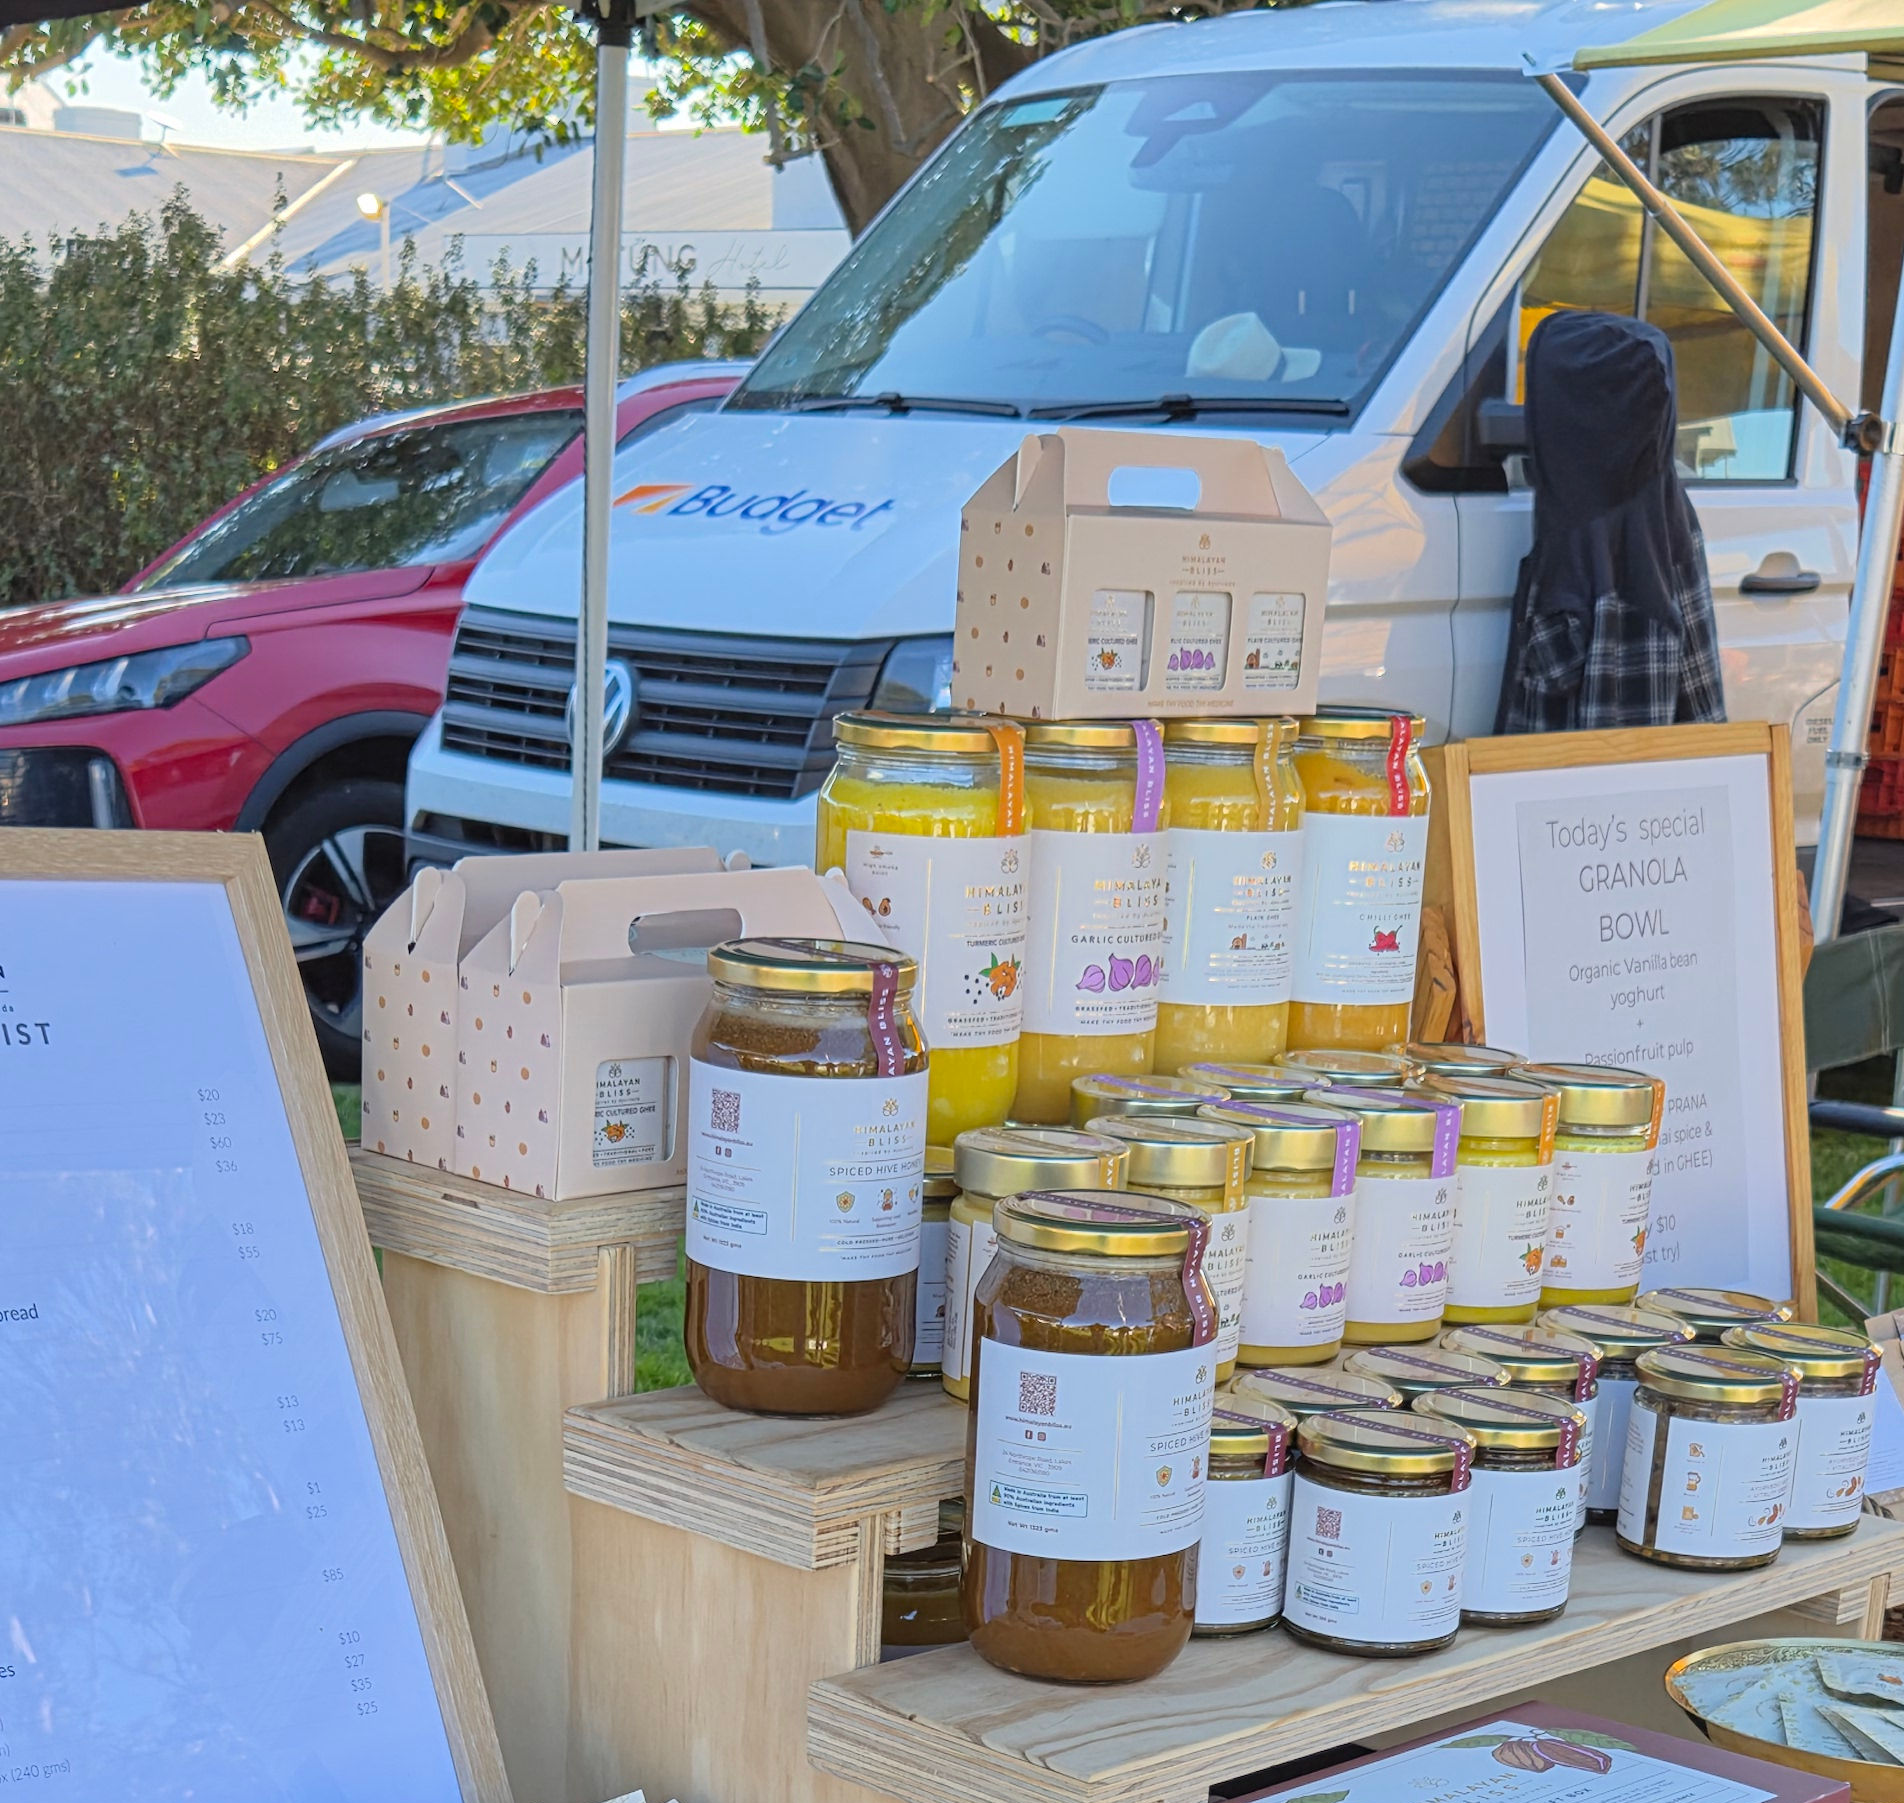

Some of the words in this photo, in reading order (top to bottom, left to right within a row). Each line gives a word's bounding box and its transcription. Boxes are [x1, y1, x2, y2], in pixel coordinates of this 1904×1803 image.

[666, 485, 895, 536] Budget
[1546, 814, 1627, 851] Today's
[1639, 807, 1705, 846] special
[1579, 856, 1688, 892] GRANOLA
[1599, 909, 1670, 942] BOWL
[1071, 934, 1114, 945] GARLIC
[1569, 960, 1621, 984] Organic
[1623, 953, 1667, 975] Vanilla
[1669, 952, 1698, 969] bean
[1610, 984, 1665, 1010] yoghurt
[1585, 1042, 1666, 1066] Passionfruit
[1668, 1038, 1694, 1058] pulp
[197, 1088, 220, 1104] $20
[1668, 1094, 1708, 1113] PRANA
[204, 1112, 226, 1127] $23
[210, 1136, 232, 1151] $60
[1674, 1126, 1702, 1146] spice
[216, 1160, 239, 1174] $36
[1677, 1149, 1713, 1171] GHEE)
[829, 1166, 873, 1177] SPICED
[876, 1163, 898, 1175] HIVE
[232, 1222, 254, 1237] $18
[1656, 1215, 1676, 1233] $10
[238, 1246, 260, 1260] $55
[1662, 1243, 1680, 1265] try)
[255, 1308, 277, 1323] $20
[261, 1332, 283, 1347] $75
[1149, 1437, 1188, 1452] SPICED
[306, 1505, 328, 1520] $25
[322, 1568, 344, 1583] $85
[338, 1630, 360, 1646] $10
[344, 1654, 365, 1669] $27
[351, 1677, 373, 1693] $35
[357, 1701, 379, 1716] $25
[1566, 1786, 1593, 1798] BOX
